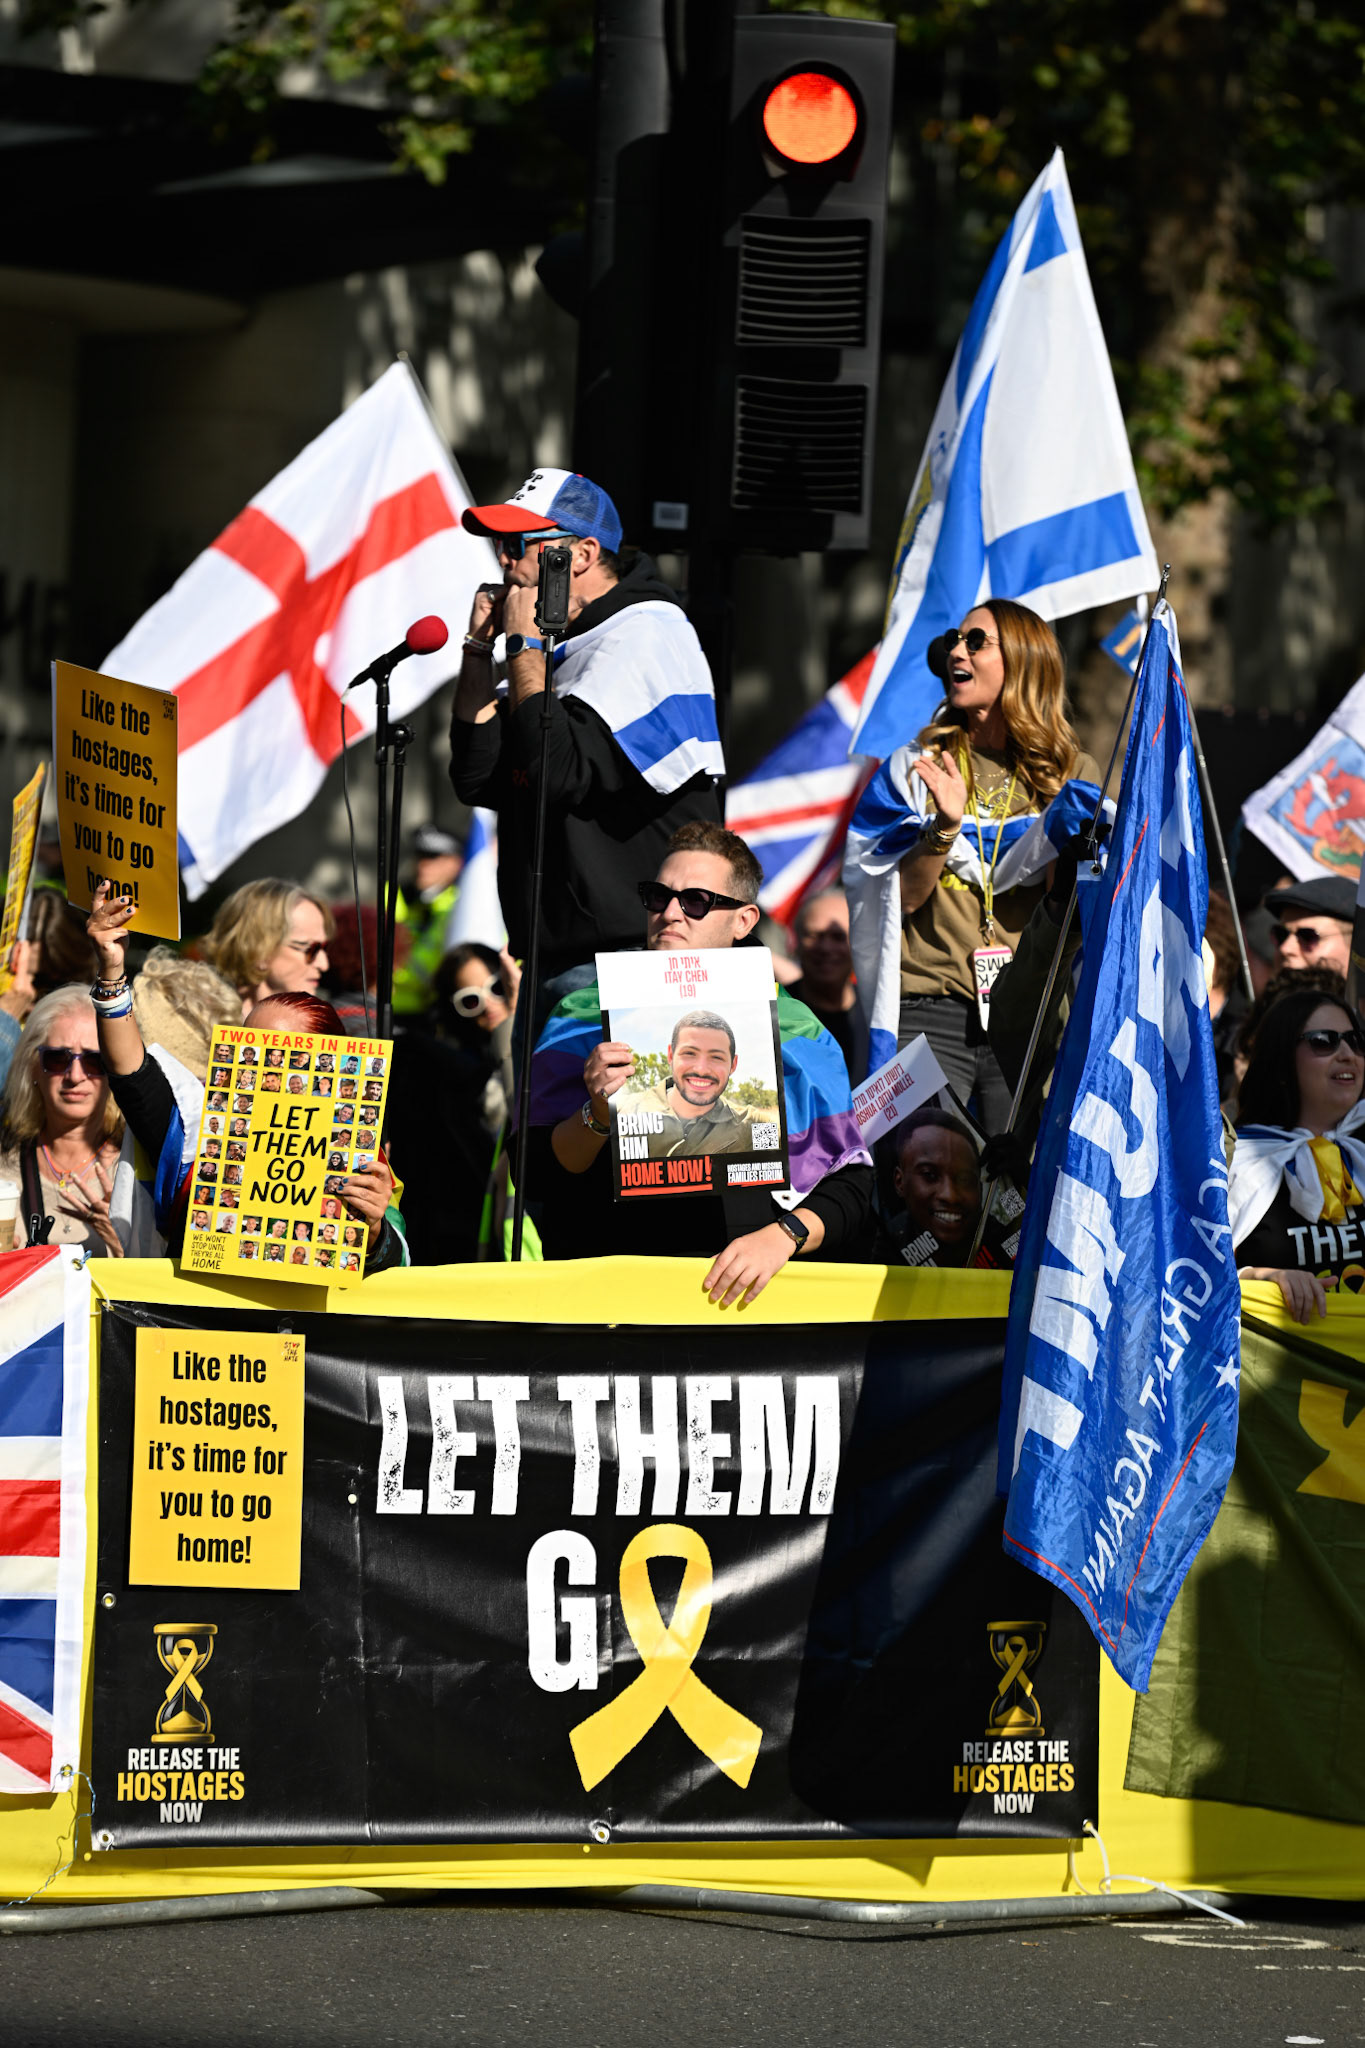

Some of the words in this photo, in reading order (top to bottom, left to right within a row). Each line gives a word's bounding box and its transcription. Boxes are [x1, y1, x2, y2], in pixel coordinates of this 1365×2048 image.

[81, 689, 115, 726] Like
[121, 702, 150, 736] the
[72, 730, 158, 786] hostages,
[94, 782, 133, 820] time
[139, 796, 166, 829] for
[74, 822, 102, 855] you
[106, 831, 124, 862] to
[130, 841, 154, 869] go
[668, 956, 678, 971] חן
[680, 956, 701, 968] איתי
[664, 970, 682, 984] ITAY
[685, 969, 708, 982] CHEN
[679, 983, 696, 999] (19)
[220, 1030, 255, 1044] TWO
[262, 1033, 313, 1049] YEARS
[321, 1039, 338, 1051] IN
[346, 1041, 385, 1056] HELL
[269, 1103, 319, 1131] LET
[617, 1112, 664, 1136] BRING
[854, 1103, 878, 1126] OSHUA
[252, 1131, 327, 1159] THEM
[619, 1136, 649, 1160] HIM
[267, 1157, 305, 1182] GO
[620, 1160, 664, 1186] HOME
[666, 1155, 713, 1183] NOW!
[728, 1170, 758, 1183] FAMILIES
[759, 1169, 783, 1181] FORUM
[249, 1181, 317, 1206] NOW
[192, 1241, 207, 1249] STOP
[208, 1243, 225, 1251] UNTIL
[901, 1230, 939, 1267] BRING
[1287, 1220, 1365, 1266] THE
[192, 1258, 221, 1269] HOME
[173, 1351, 220, 1381] Like
[229, 1354, 267, 1383] the
[160, 1396, 278, 1432] hostages,
[194, 1443, 246, 1473] time
[254, 1446, 287, 1475] for
[376, 1375, 530, 1515] LET
[557, 1375, 840, 1516] THEM
[160, 1491, 203, 1519] you
[211, 1490, 234, 1518] to
[242, 1494, 271, 1522] go
[177, 1533, 251, 1564] home!
[127, 1747, 204, 1771] RELEASE
[206, 1747, 240, 1770] THE
[963, 1741, 1034, 1763] RELEASE
[1037, 1740, 1069, 1762] THE
[117, 1771, 245, 1801] HOSTAGES
[953, 1763, 1075, 1793] HOSTAGES
[160, 1802, 203, 1823] NOW
[994, 1793, 1035, 1814] NOW
